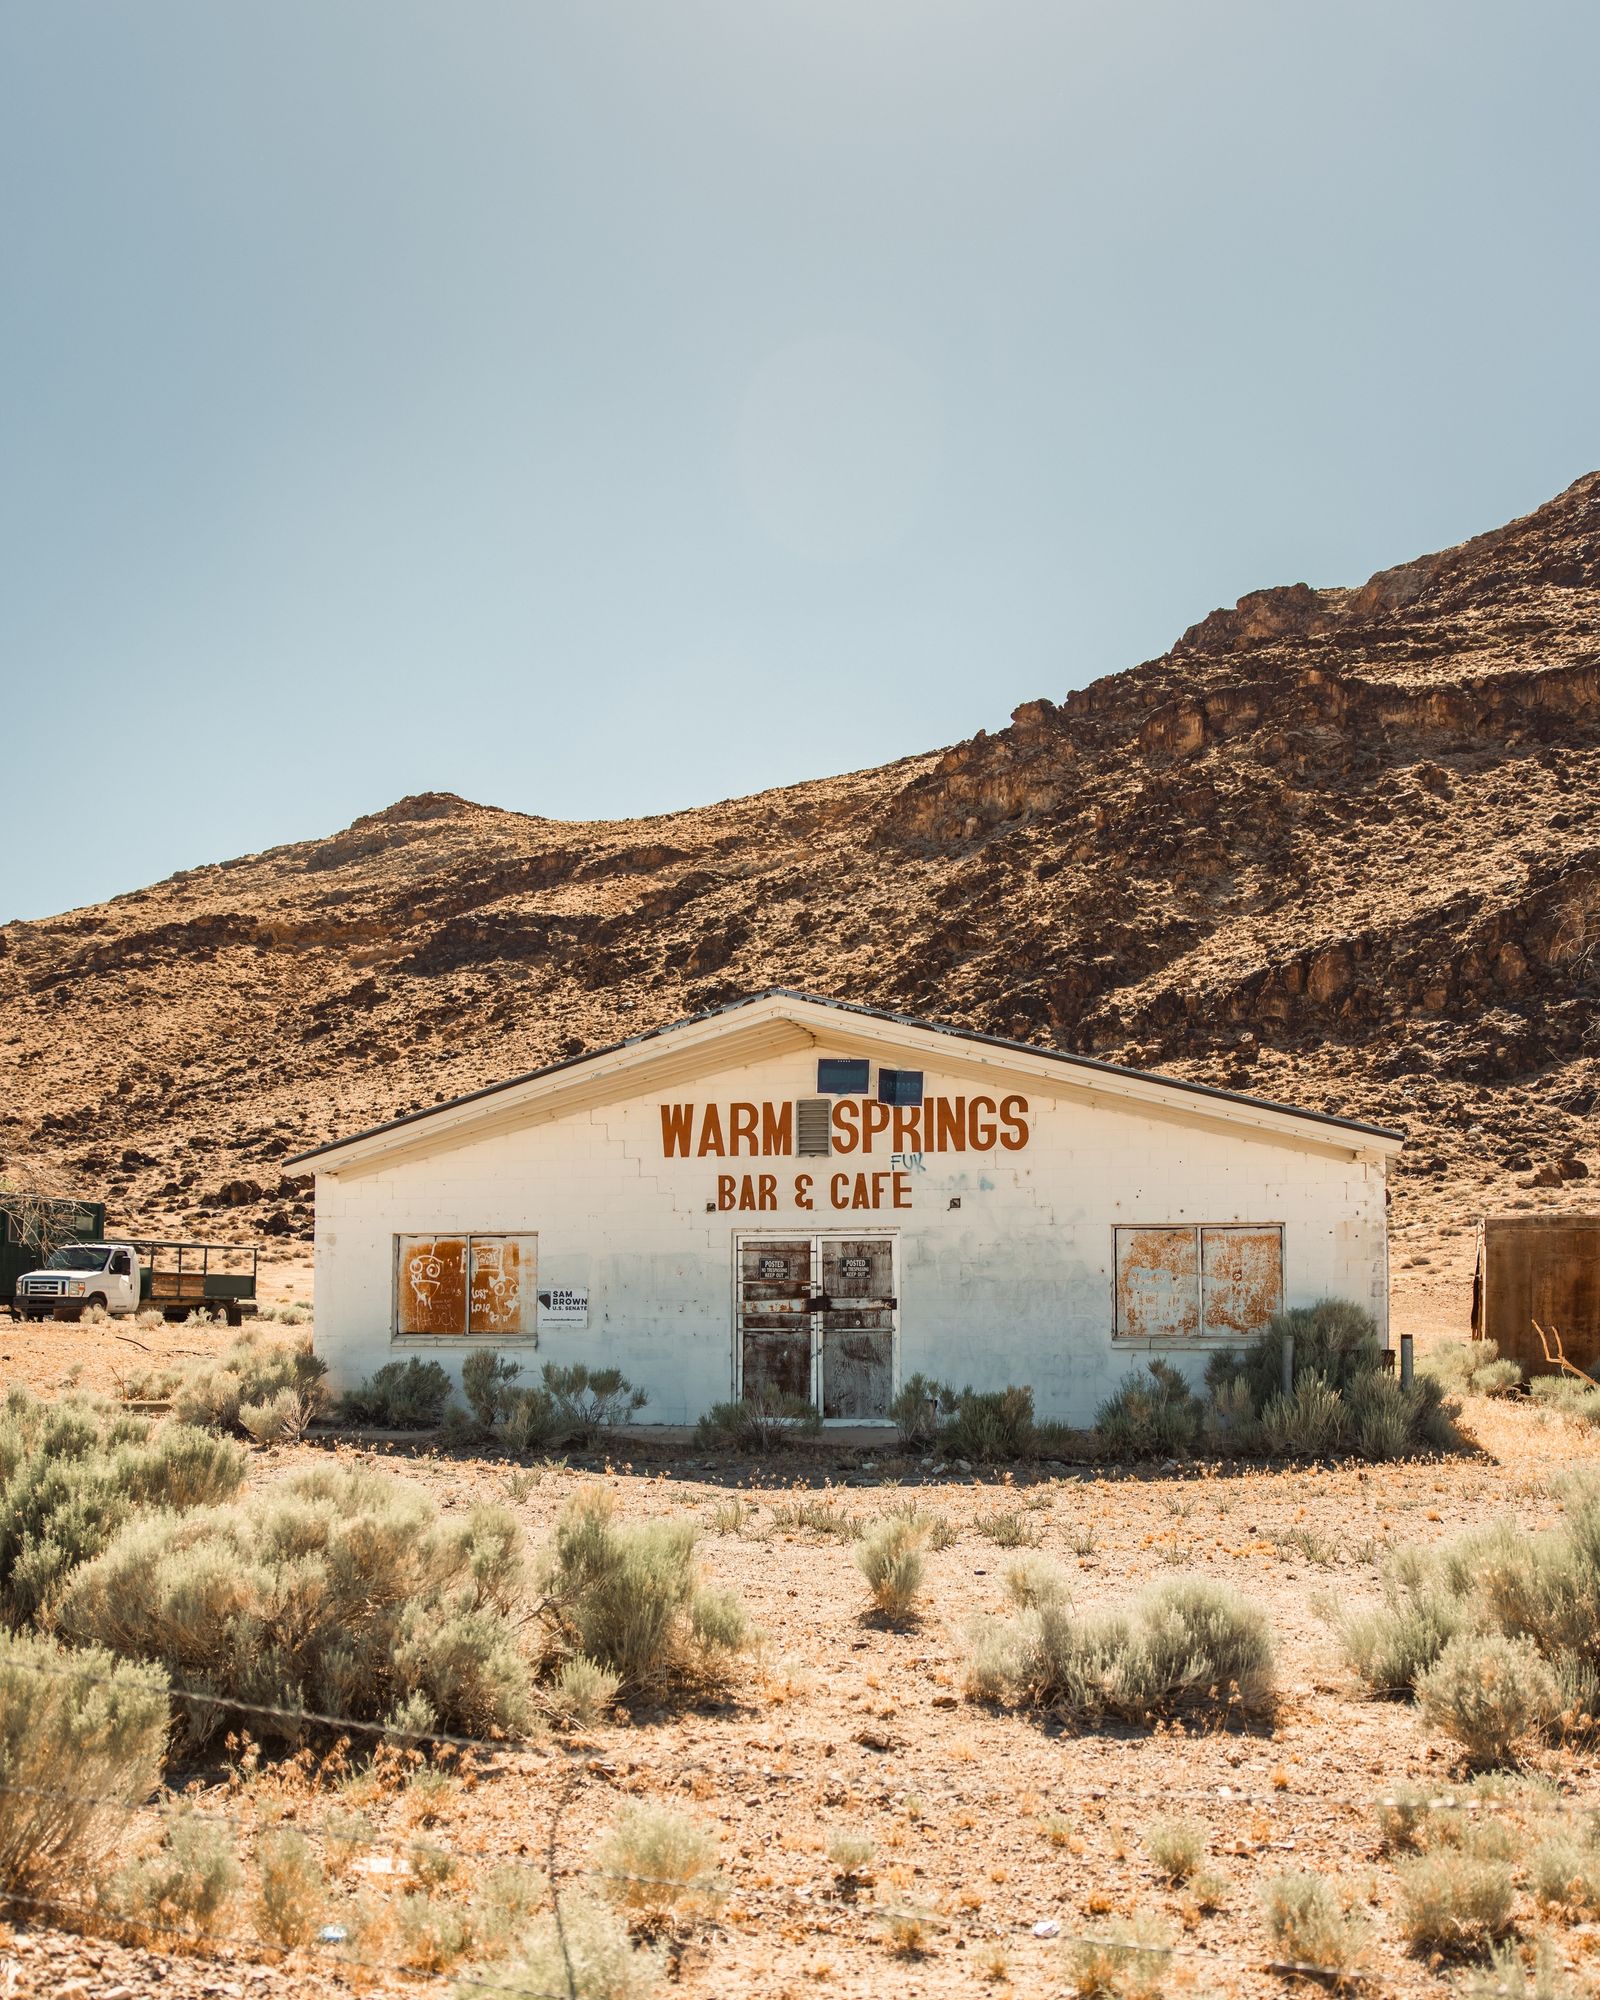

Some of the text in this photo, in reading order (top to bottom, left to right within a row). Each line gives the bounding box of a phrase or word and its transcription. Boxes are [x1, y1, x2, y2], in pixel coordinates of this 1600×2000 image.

[660, 1095, 1030, 1158] WARM SPRINGS
[717, 1172, 913, 1211] BAR & CAFE
[764, 1260, 785, 1268] POSTED
[846, 1259, 866, 1267] POSTED
[552, 1290, 573, 1298] SAM
